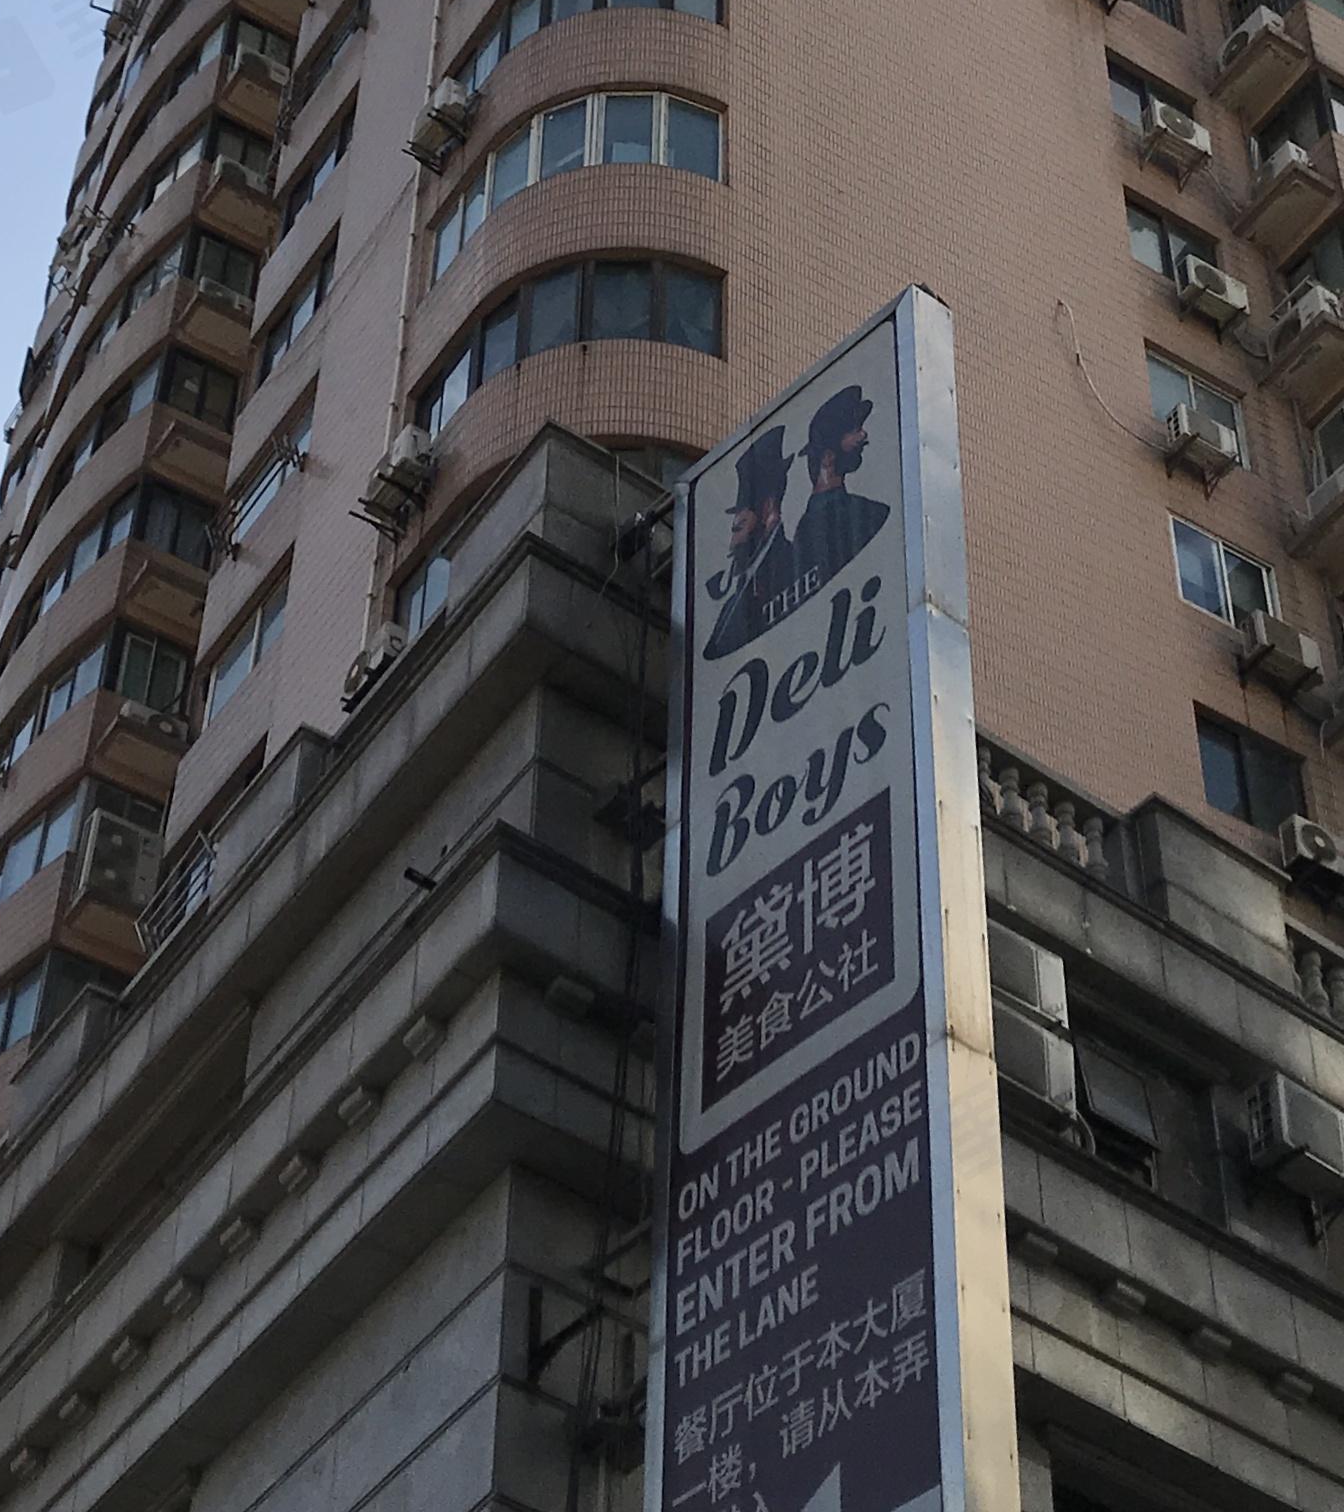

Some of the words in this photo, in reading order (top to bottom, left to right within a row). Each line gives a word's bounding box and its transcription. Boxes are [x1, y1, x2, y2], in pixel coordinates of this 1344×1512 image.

[709, 575, 886, 777] Deli
[762, 565, 821, 624] THE
[707, 702, 890, 877] Boys
[716, 928, 878, 1082] 美食公社
[719, 822, 876, 1015] 黛博
[677, 1178, 775, 1276] FLOOR
[800, 1080, 923, 1193] PLEASE
[678, 1164, 719, 1222] ON
[726, 1120, 782, 1187] THE
[789, 1033, 921, 1144] GROUND
[674, 1320, 731, 1387] THE
[739, 1264, 819, 1349] LANE
[676, 1220, 795, 1336] ENTER
[806, 1137, 920, 1250] FROM
[674, 1267, 927, 1465] 餐厅位于本大厦
